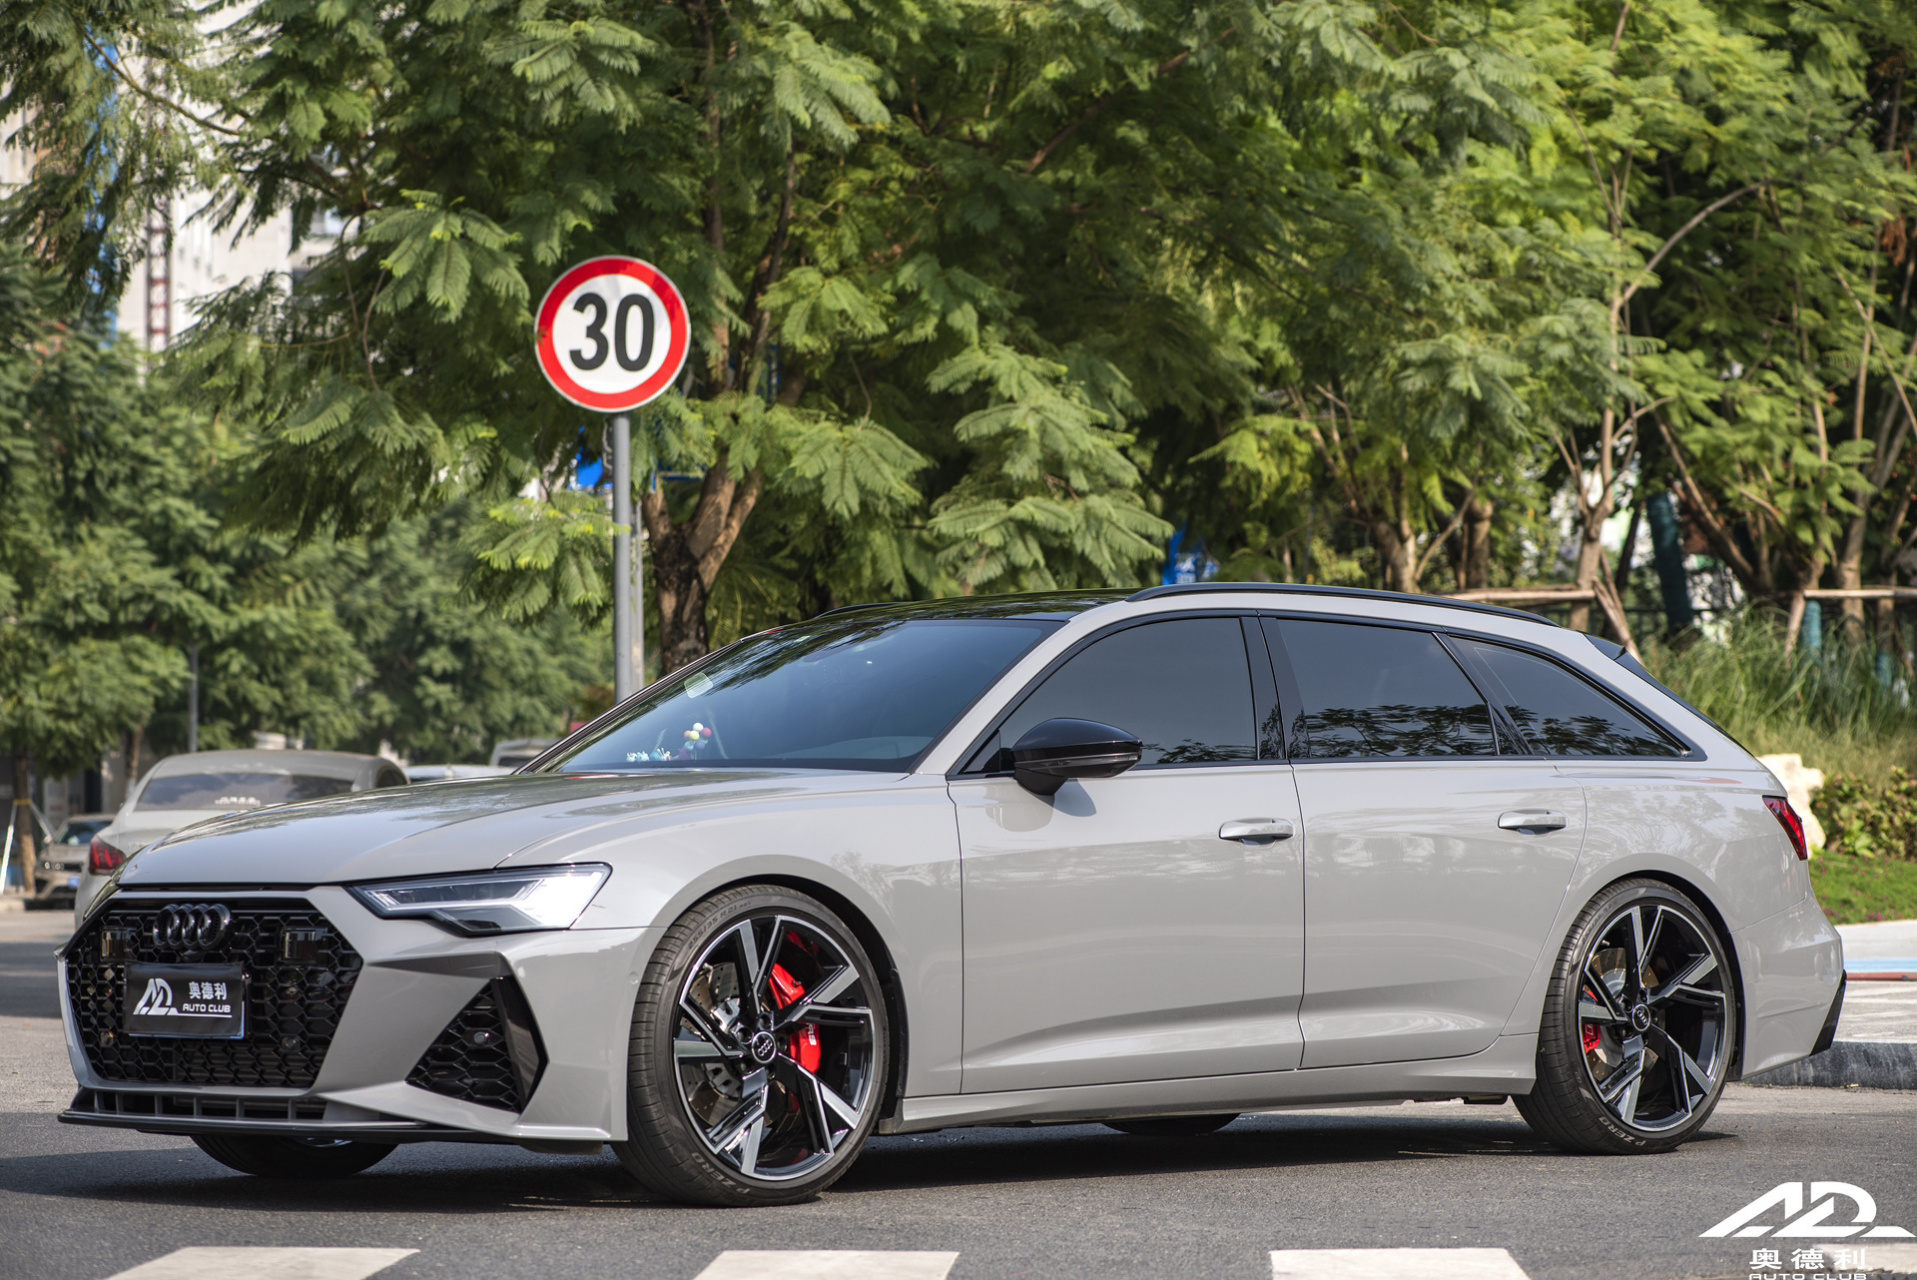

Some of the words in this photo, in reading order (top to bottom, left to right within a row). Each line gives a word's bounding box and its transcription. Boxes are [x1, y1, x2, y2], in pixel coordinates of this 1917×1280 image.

[569, 292, 656, 373] 30
[188, 981, 228, 1000] 奥德利
[182, 1003, 207, 1013] AUTO
[208, 1004, 232, 1013] CLUB
[1598, 1116, 1636, 1143] ZERO
[690, 1152, 737, 1188] ZERO
